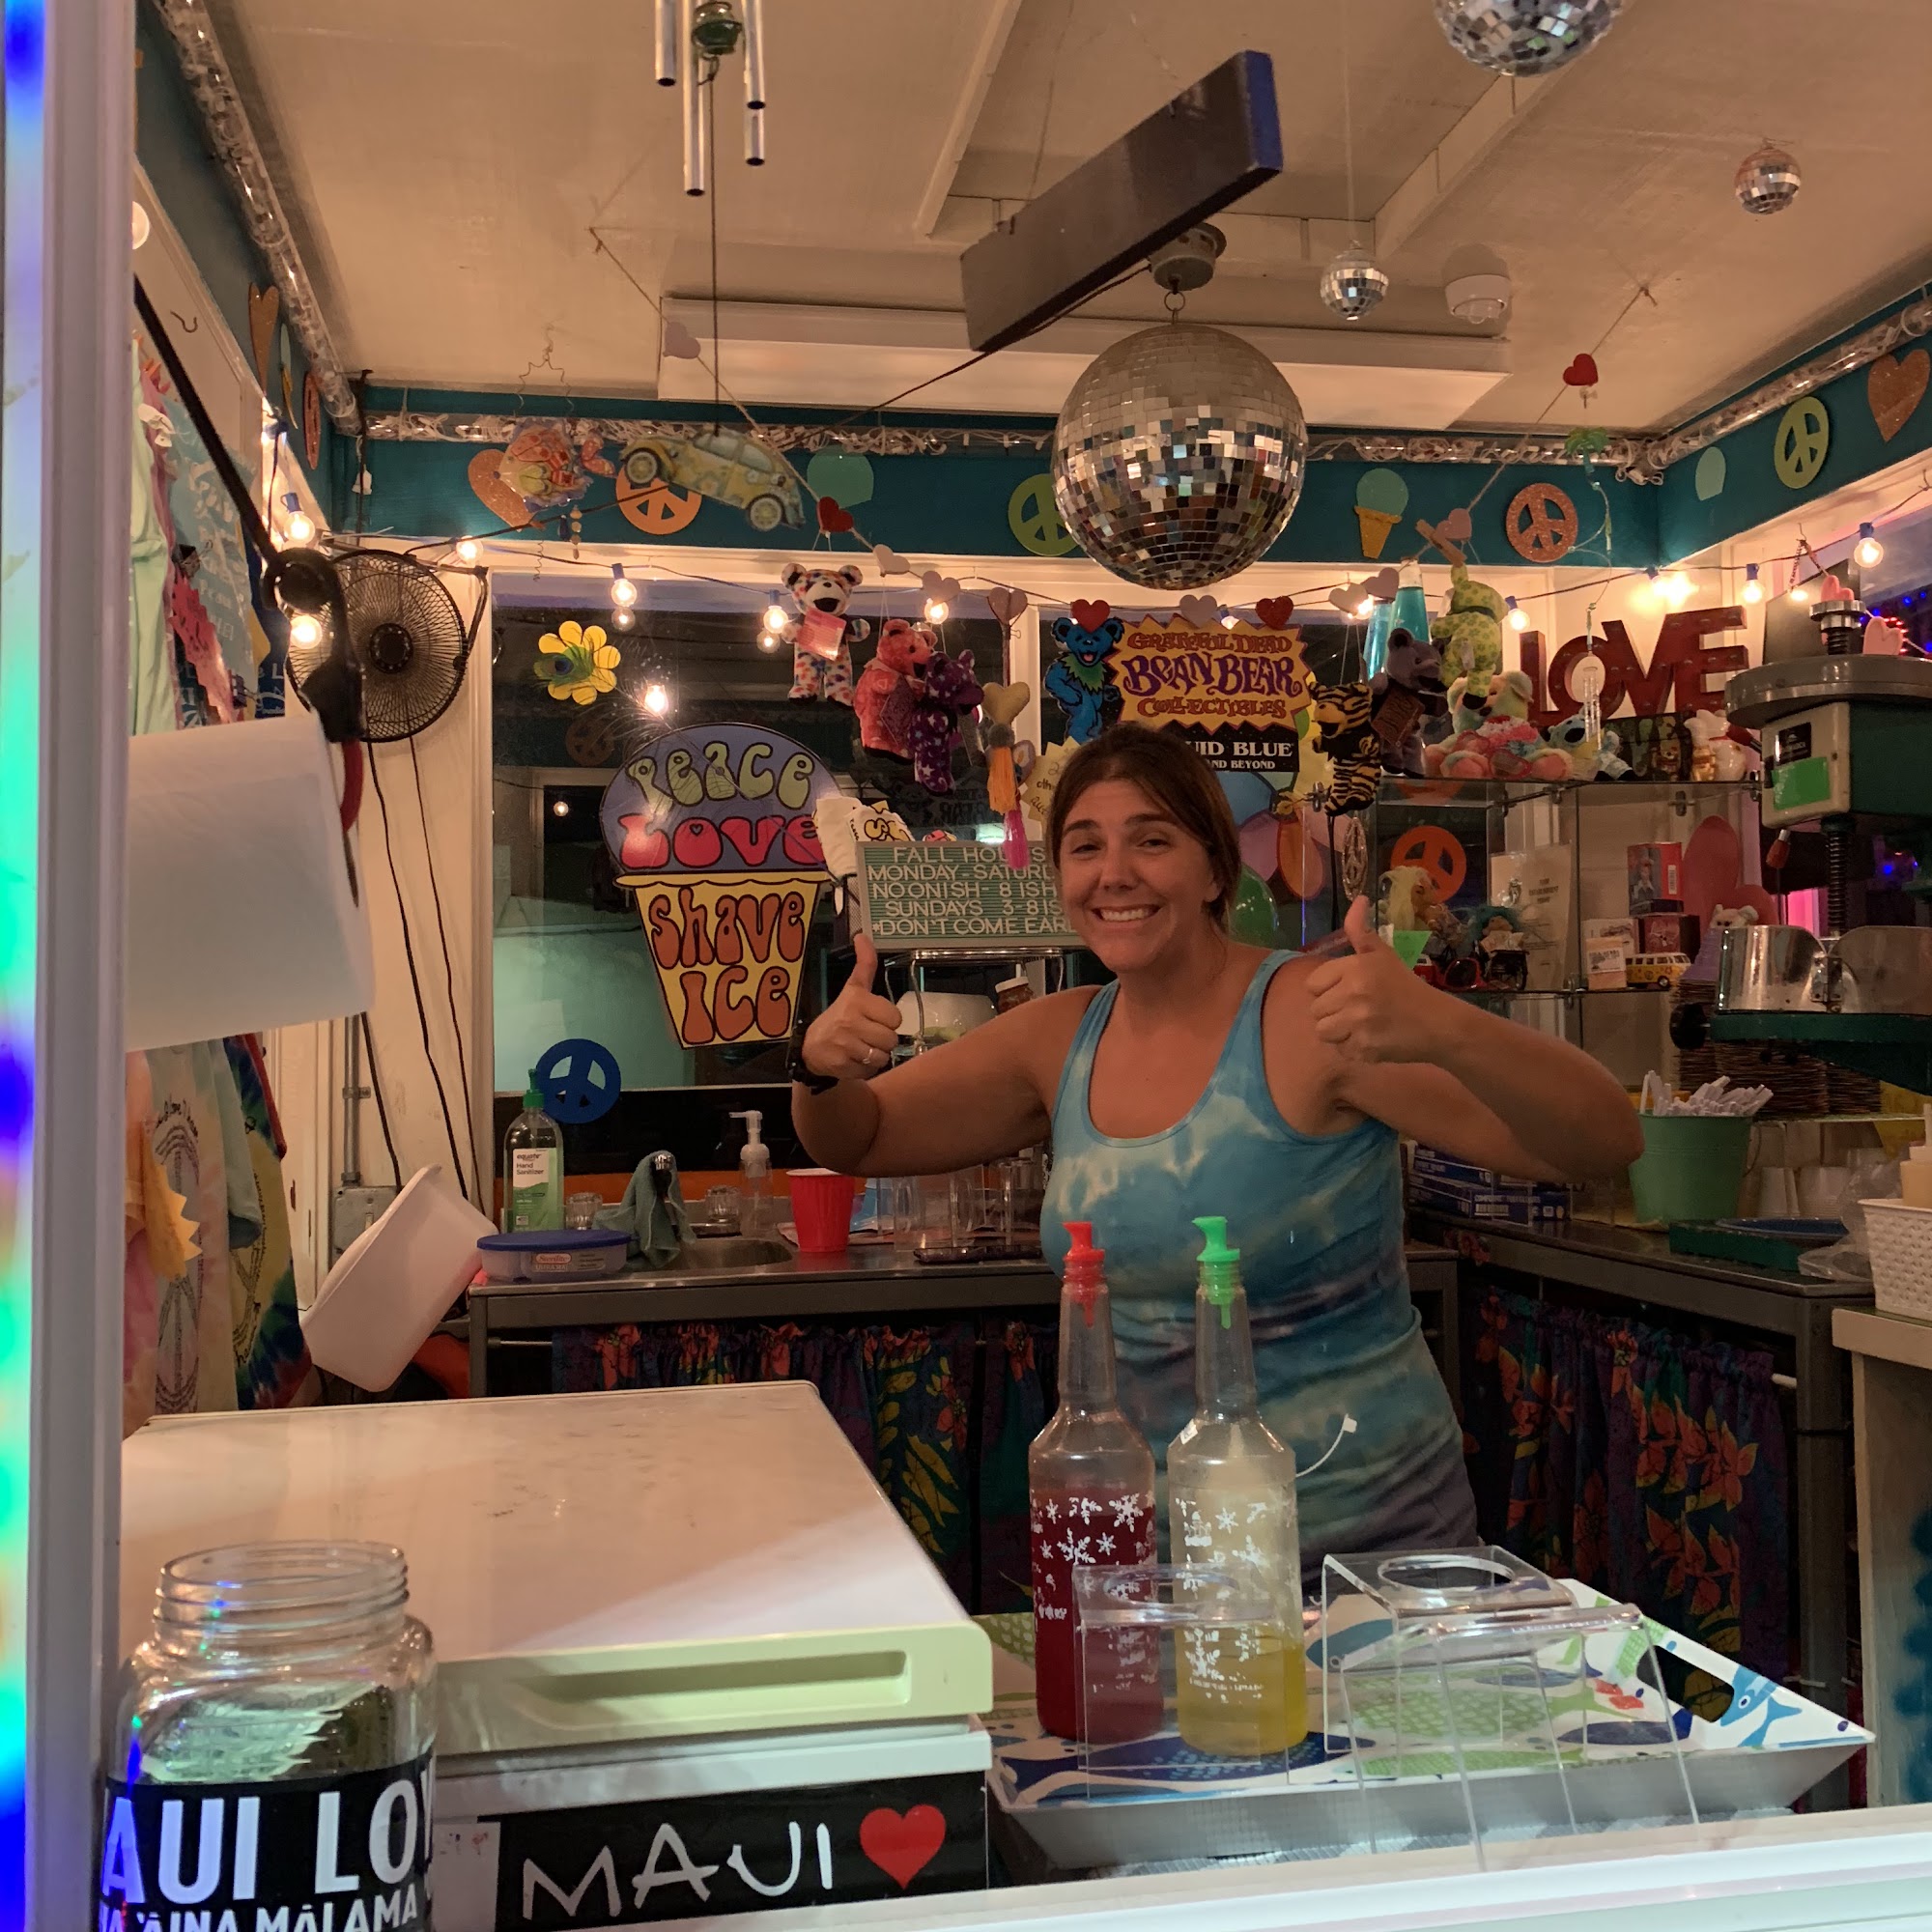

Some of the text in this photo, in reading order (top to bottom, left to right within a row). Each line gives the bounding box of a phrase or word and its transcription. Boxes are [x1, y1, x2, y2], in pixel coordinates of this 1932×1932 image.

[1127, 632, 1293, 654] GRATEFUL DEAD
[1207, 654, 1303, 697] BEAR
[1520, 605, 1750, 729] LOVE
[1137, 696, 1287, 719] COLLECTIBLES
[1233, 741, 1293, 756] BLUE
[1231, 759, 1275, 770] BEYOND
[894, 846, 953, 863] FALL
[868, 864, 959, 881] MONDAY
[1000, 881, 1012, 897] 8
[1019, 881, 1058, 898] ISH
[886, 899, 983, 917] SUNDAYS
[953, 917, 1020, 935] COME
[101, 1796, 261, 1904] AUI
[523, 1821, 833, 1919] MAUI
